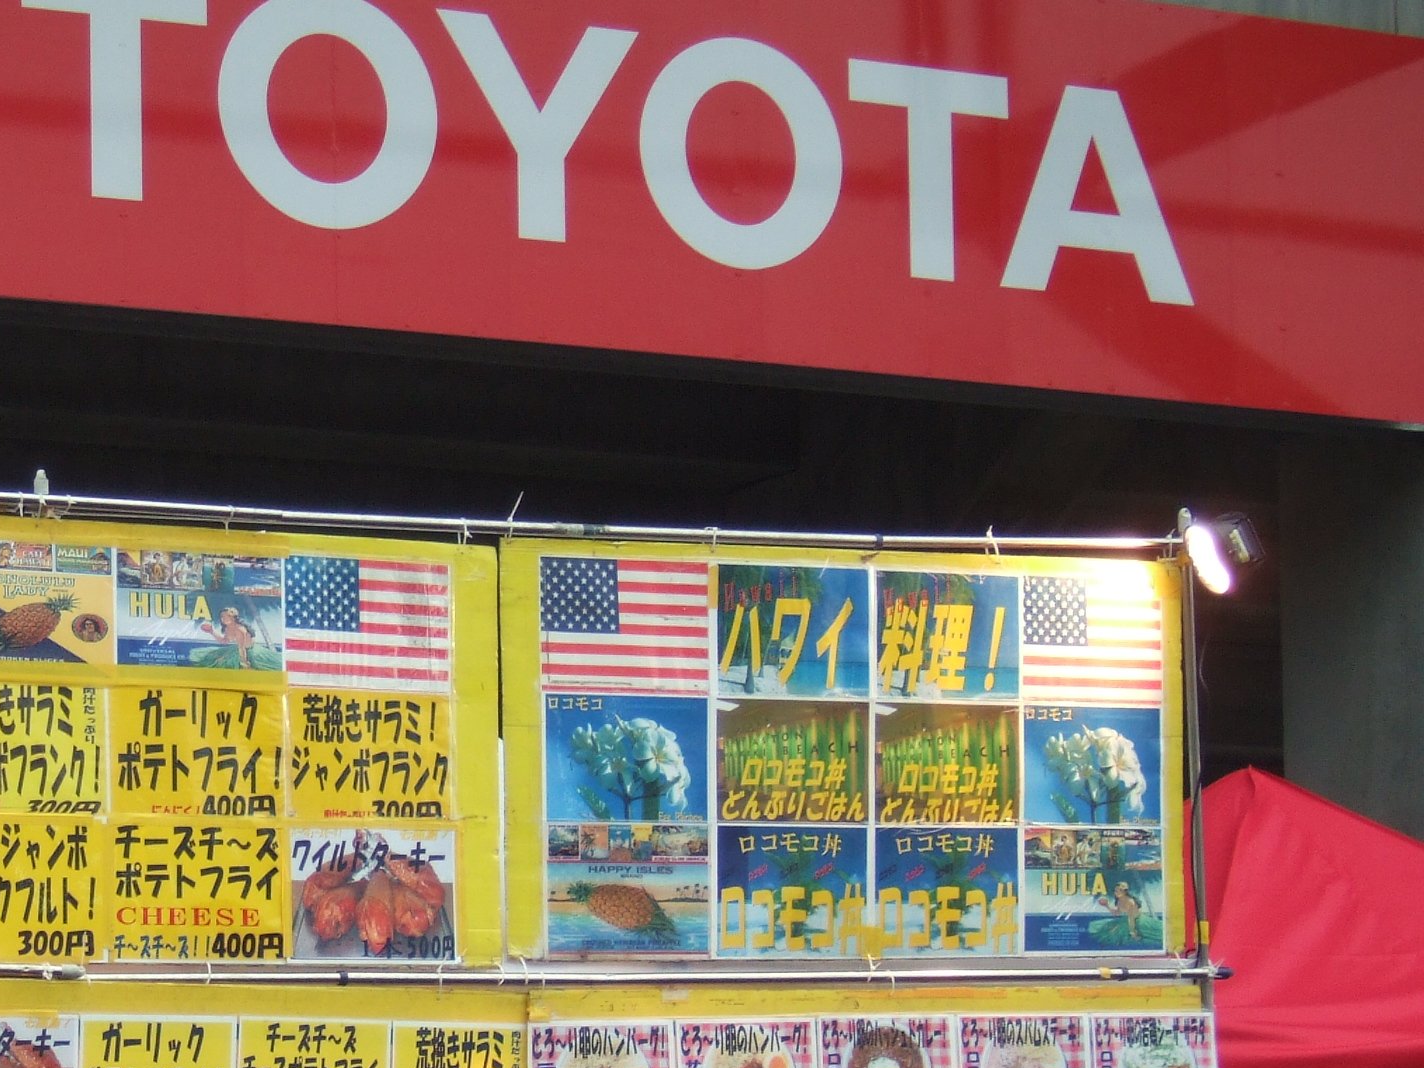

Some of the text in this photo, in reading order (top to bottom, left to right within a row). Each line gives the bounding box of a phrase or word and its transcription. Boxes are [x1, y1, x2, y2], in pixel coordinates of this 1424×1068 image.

[21, 0, 1194, 307] TOYOTA
[3, 585, 50, 599] LADY
[129, 591, 213, 621] HULA
[721, 597, 853, 690] ハワイ
[878, 597, 1006, 693] 料理!
[140, 690, 258, 739] ガーリック
[548, 697, 602, 711] ロコモコ
[118, 741, 281, 794] ポテトフライ!
[293, 745, 448, 796] ジャンボフランク
[203, 795, 276, 816] 400円
[371, 800, 443, 818] 300円
[722, 790, 865, 821] どんぶりごはん
[292, 841, 446, 873] ワイルドターキー
[588, 866, 674, 875] HAPPY ISLES
[116, 864, 279, 901] ポテトフライ
[1041, 872, 1108, 896] HULA
[116, 907, 260, 926] CHEESE
[18, 931, 94, 956] 300円
[211, 933, 284, 958] 400円
[102, 1022, 205, 1063] ガーリック
